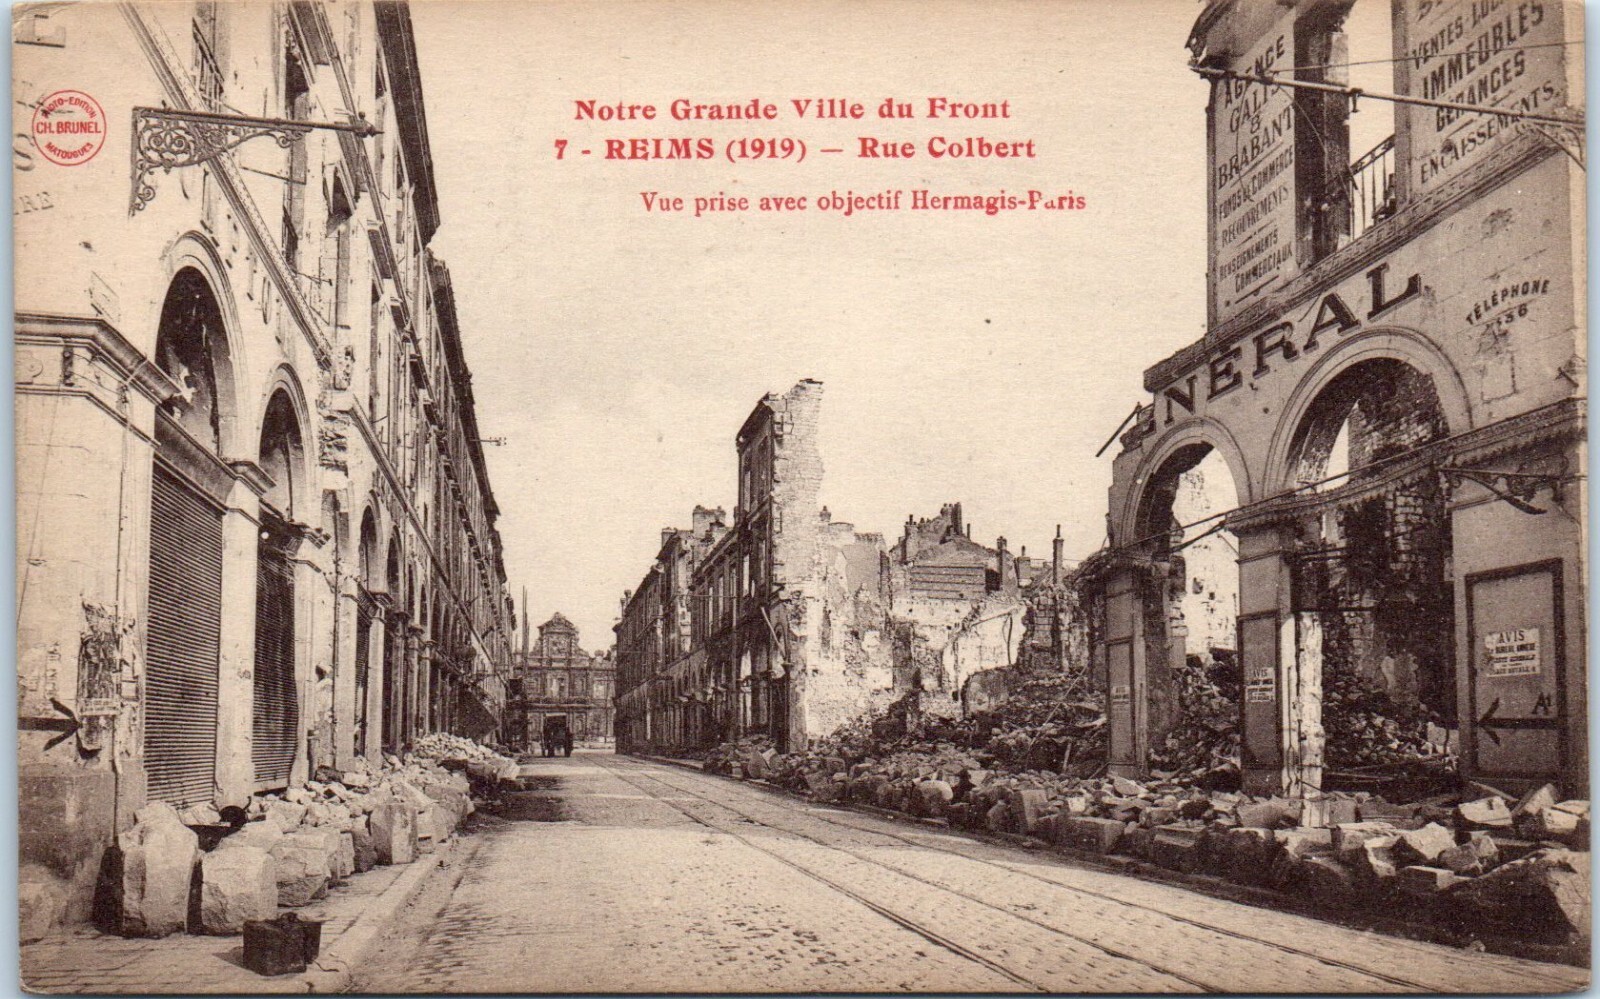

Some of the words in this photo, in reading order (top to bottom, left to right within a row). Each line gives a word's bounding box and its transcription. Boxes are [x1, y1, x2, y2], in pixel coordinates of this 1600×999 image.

[1224, 33, 1286, 110] AGENCE
[1411, 15, 1464, 70] VENTES
[1422, 0, 1545, 101] IMMEUBLES
[1217, 105, 1294, 190] BRABANT
[1465, 279, 1551, 325] TÉLÉPHONE
[1499, 630, 1525, 643] AVIS
